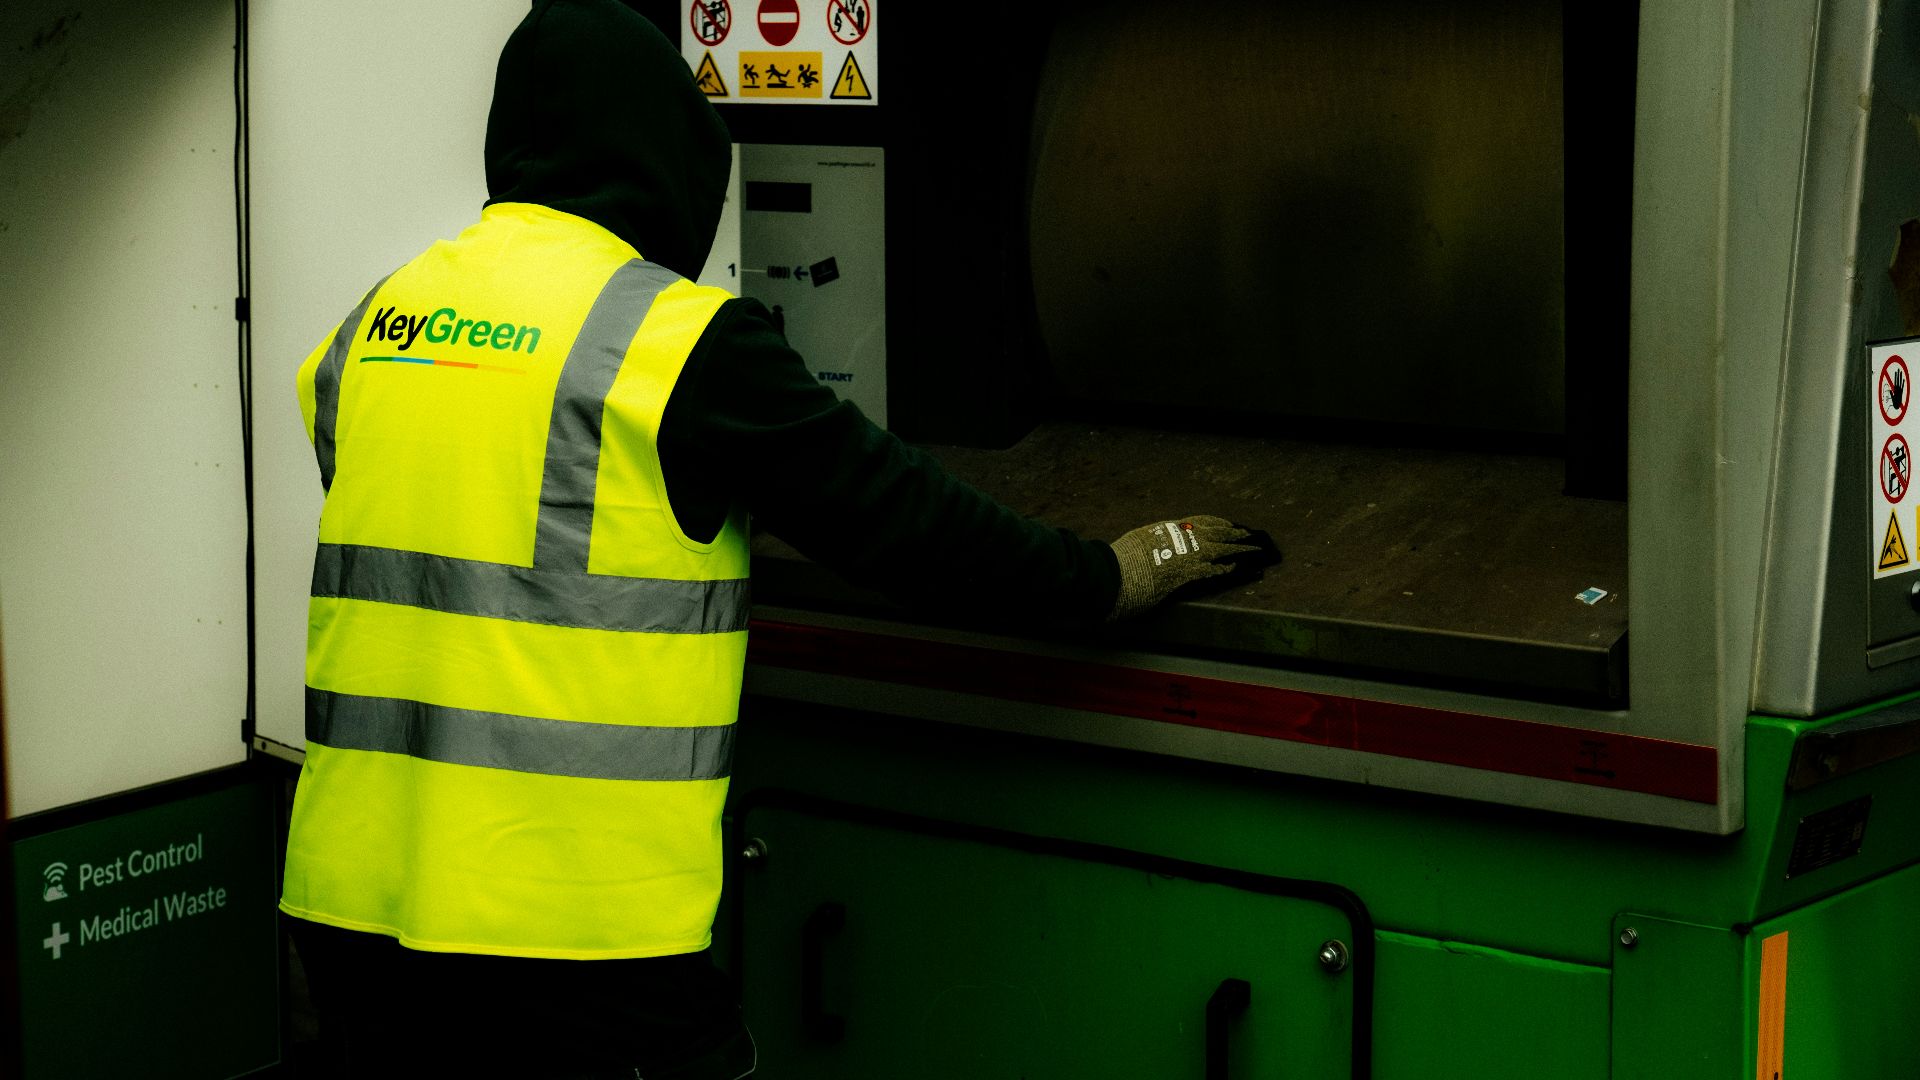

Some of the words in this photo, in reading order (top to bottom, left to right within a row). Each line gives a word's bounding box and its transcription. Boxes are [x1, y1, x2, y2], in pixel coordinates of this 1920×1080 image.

[728, 263, 735, 277] 1
[366, 306, 541, 354] KeyGreen
[818, 372, 853, 382] START
[79, 857, 124, 892] Pest
[127, 832, 203, 878] Control
[79, 898, 159, 946] Medical
[163, 885, 227, 922] Waste
